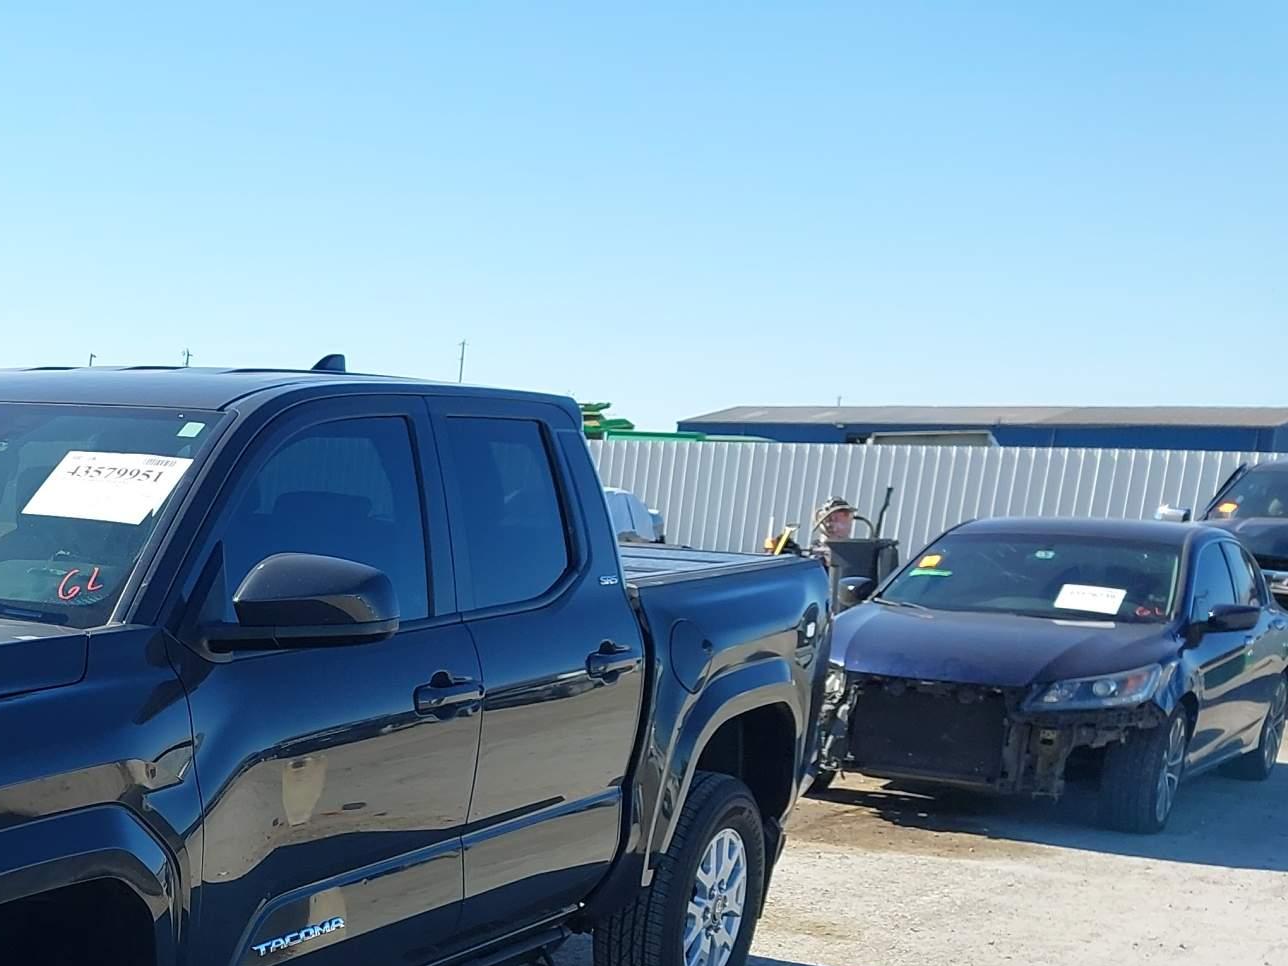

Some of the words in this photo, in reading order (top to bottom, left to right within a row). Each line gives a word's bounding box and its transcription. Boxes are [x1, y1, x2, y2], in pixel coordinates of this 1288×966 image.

[66, 465, 164, 483] 43579951
[599, 575, 619, 586] SR5
[252, 917, 345, 956] TACOMA
